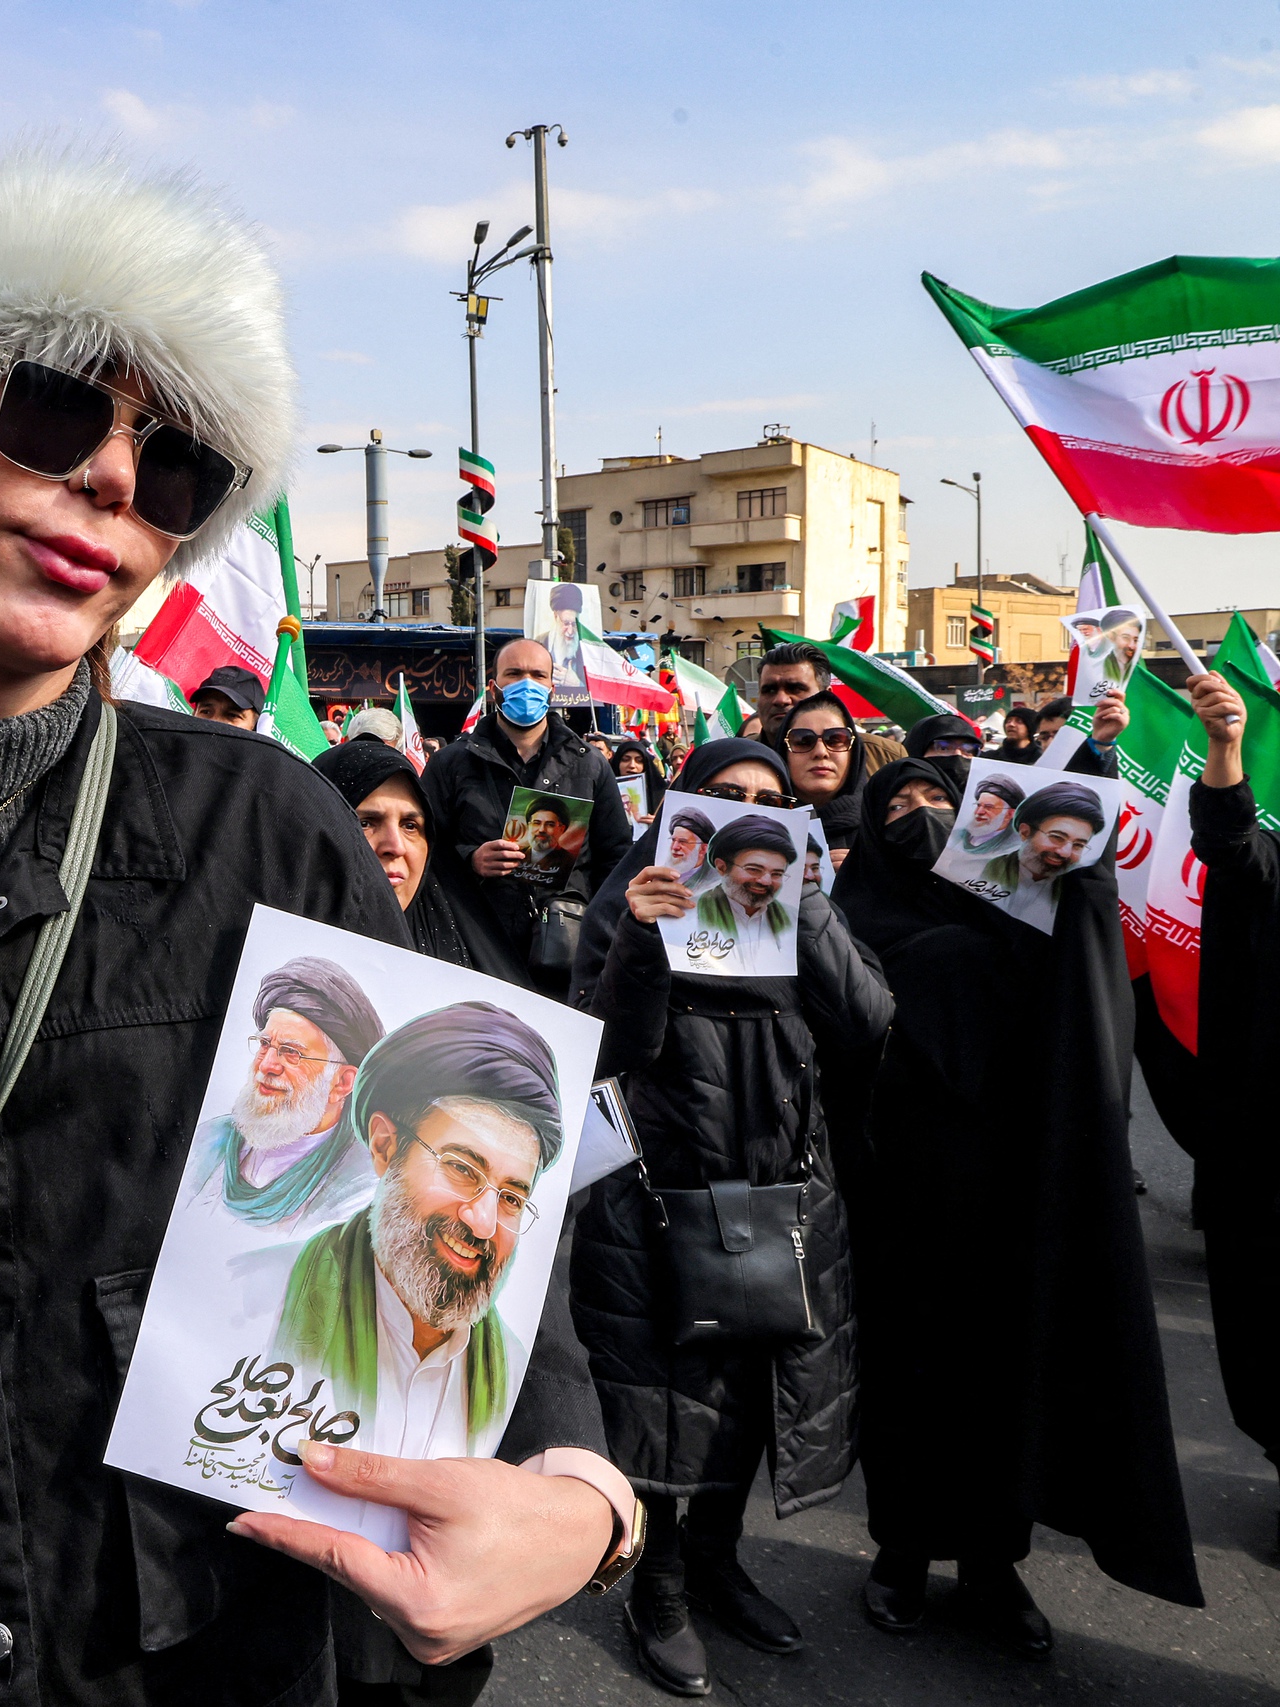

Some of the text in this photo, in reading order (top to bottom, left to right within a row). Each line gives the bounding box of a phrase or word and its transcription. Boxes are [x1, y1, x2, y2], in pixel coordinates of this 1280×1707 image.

[194, 1354, 361, 1466] صالح بعد صالح
